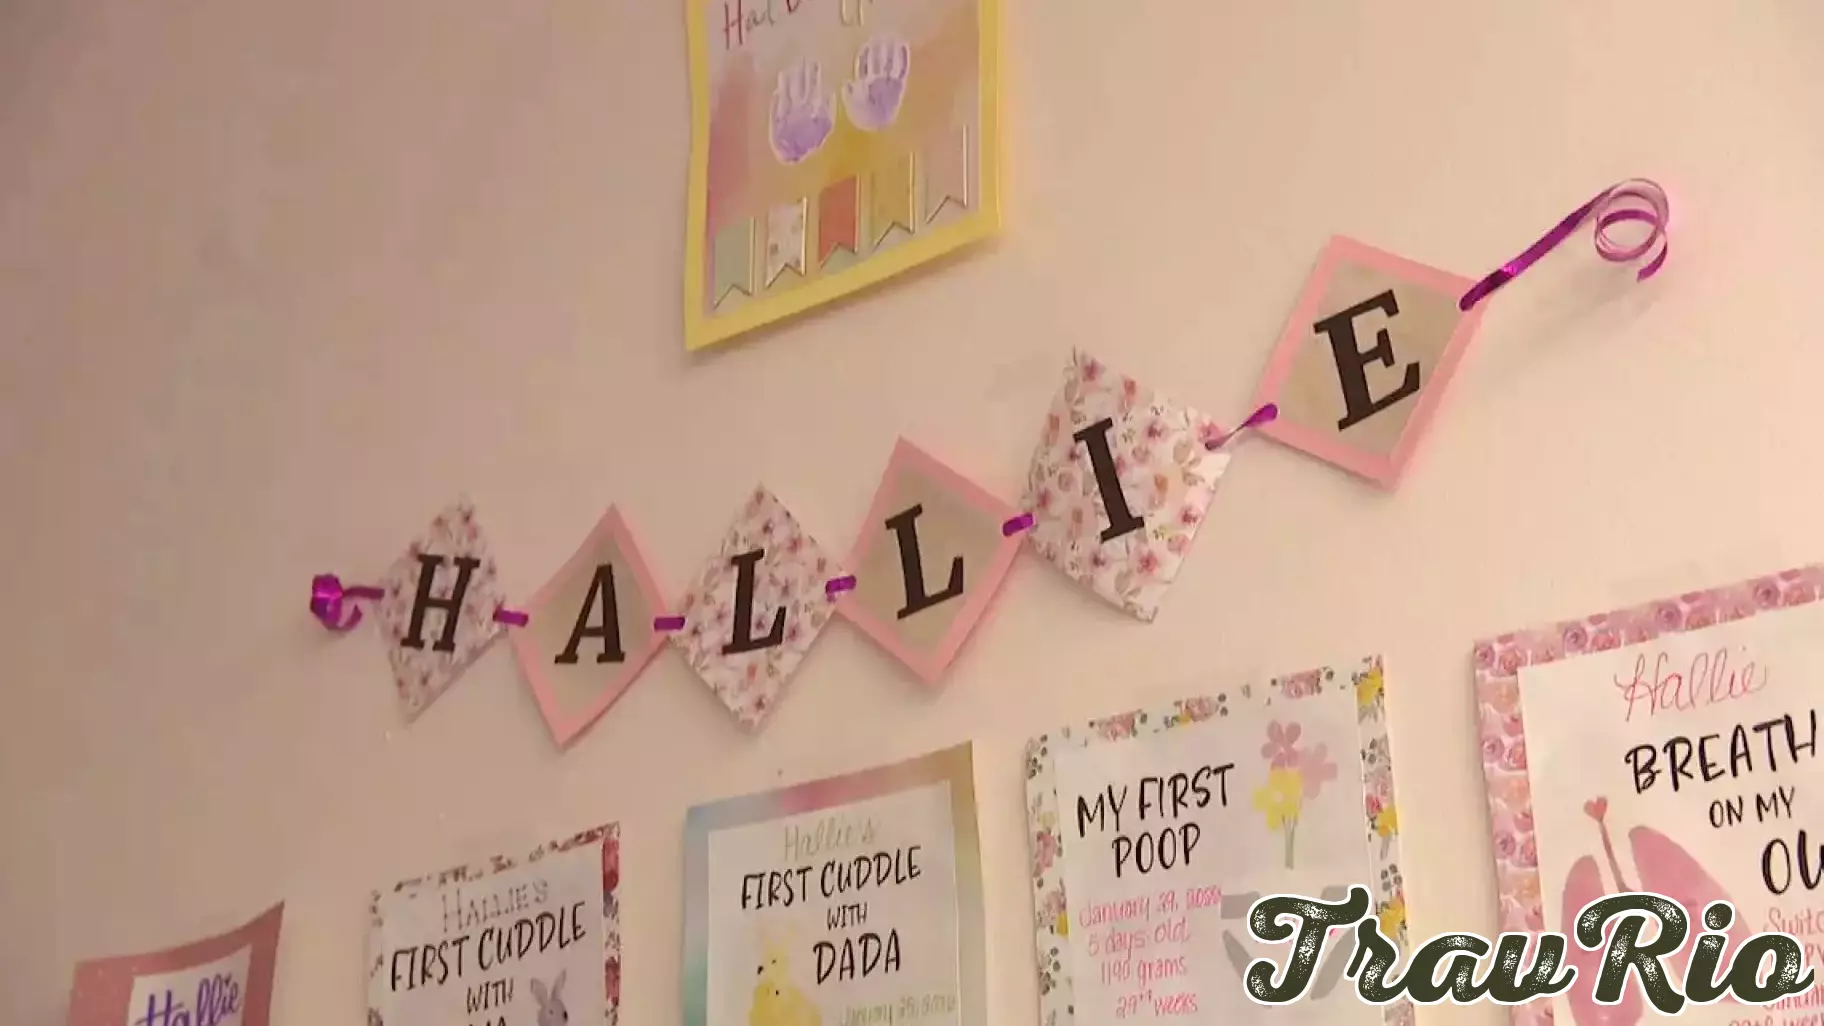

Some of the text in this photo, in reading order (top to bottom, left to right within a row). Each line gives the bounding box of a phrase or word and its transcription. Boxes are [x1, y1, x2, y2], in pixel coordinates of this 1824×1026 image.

[1613, 645, 1770, 721] Hallie
[1624, 709, 1816, 794] BREATH
[1076, 762, 1235, 837] MY FIRST
[1708, 786, 1795, 828] ON MY
[740, 845, 922, 909] FIRST CUDDLE
[1111, 822, 1201, 878] POOP
[826, 901, 868, 931] WITH
[1105, 926, 1146, 960] days
[391, 901, 586, 991] FIRST CUDDLE
[812, 928, 901, 985] DADA
[1137, 956, 1187, 987] grams
[466, 977, 514, 1014] WITH
